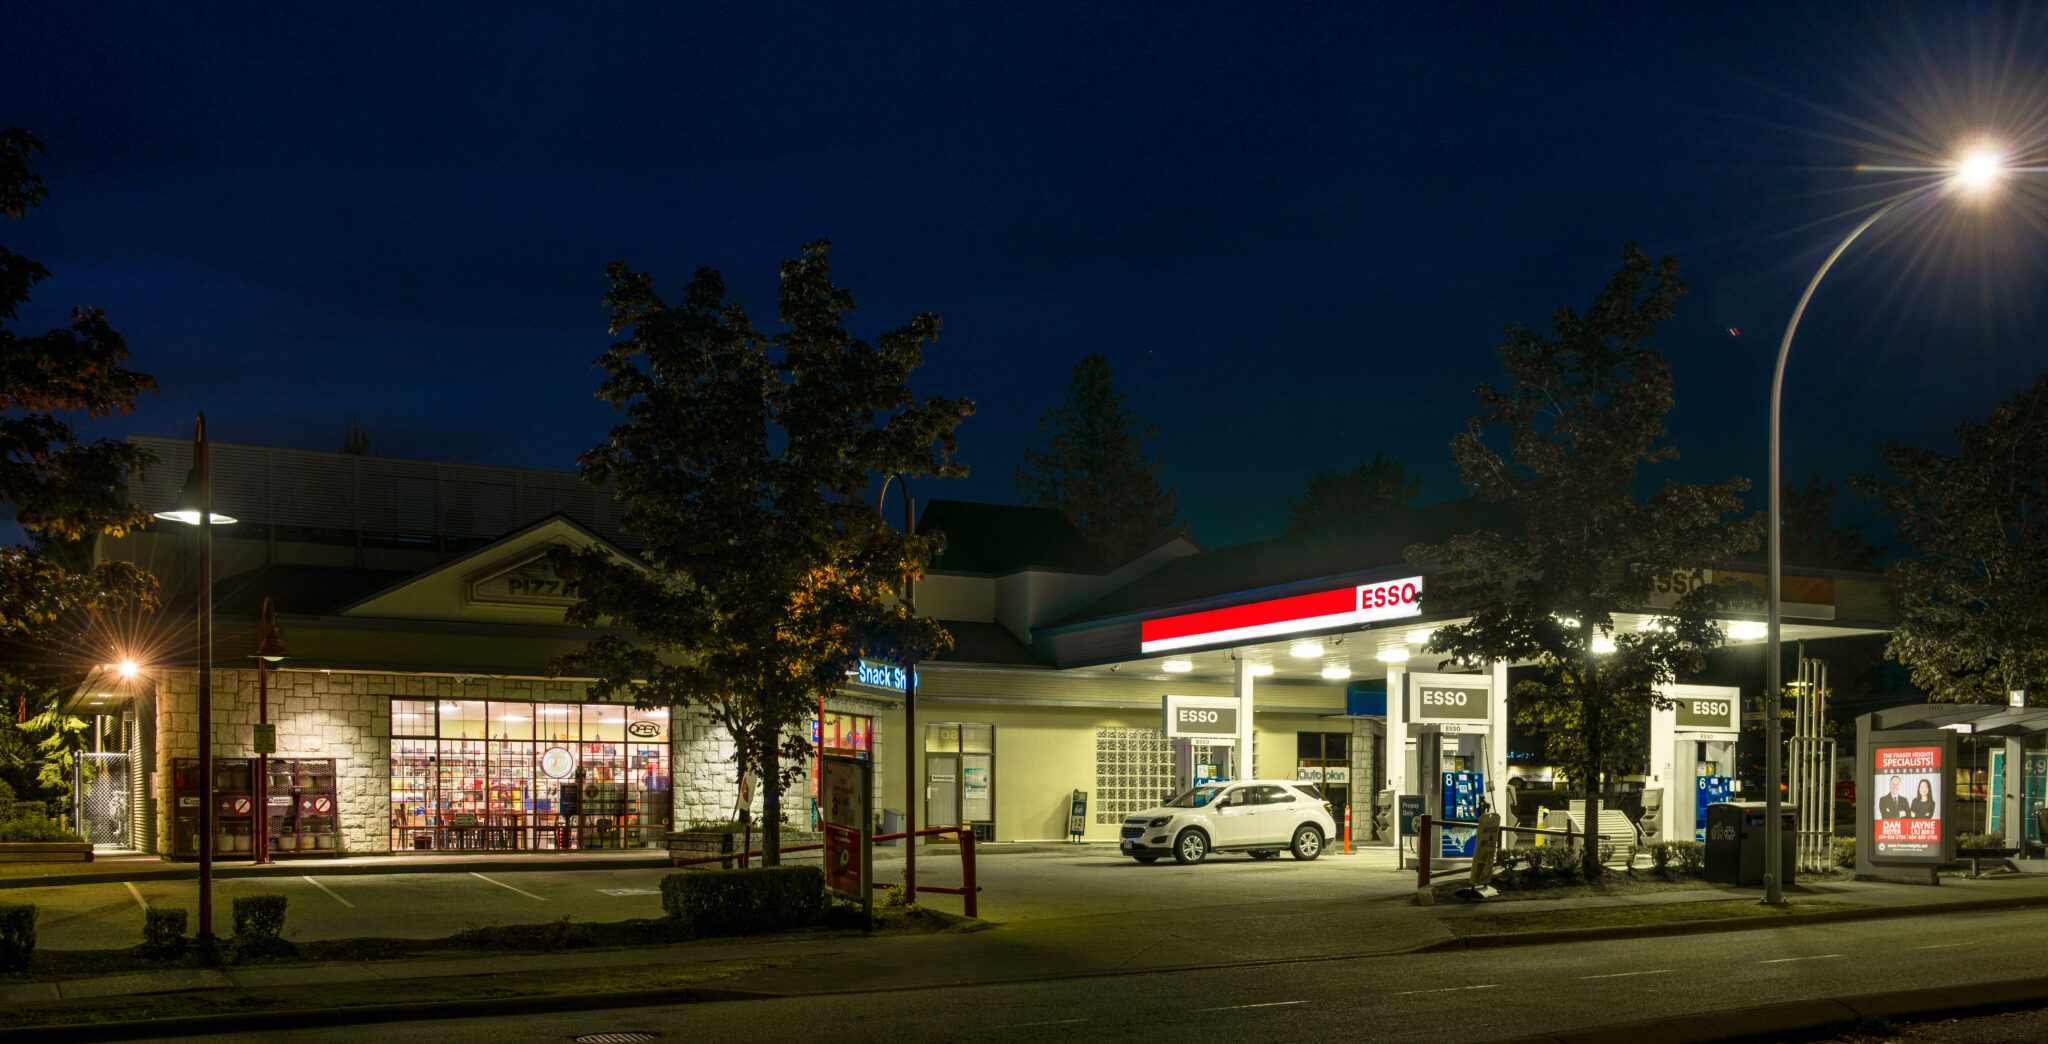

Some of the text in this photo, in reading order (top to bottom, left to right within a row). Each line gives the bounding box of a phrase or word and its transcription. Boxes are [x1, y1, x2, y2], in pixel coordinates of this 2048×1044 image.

[1648, 572, 1705, 594] SSO
[1362, 582, 1416, 609] ESSO
[858, 660, 918, 690] Snack Sh
[1423, 690, 1467, 706] ESSO
[1693, 701, 1729, 716] ESSO
[1179, 709, 1218, 723] ESSO
[629, 722, 661, 736] OPEN
[1882, 757, 1934, 767] SPECIALISTS!
[1445, 773, 1453, 787] 8
[1699, 777, 1706, 790] 6
[1883, 821, 1901, 830] DAN
[1911, 821, 1935, 830] JAYNE
